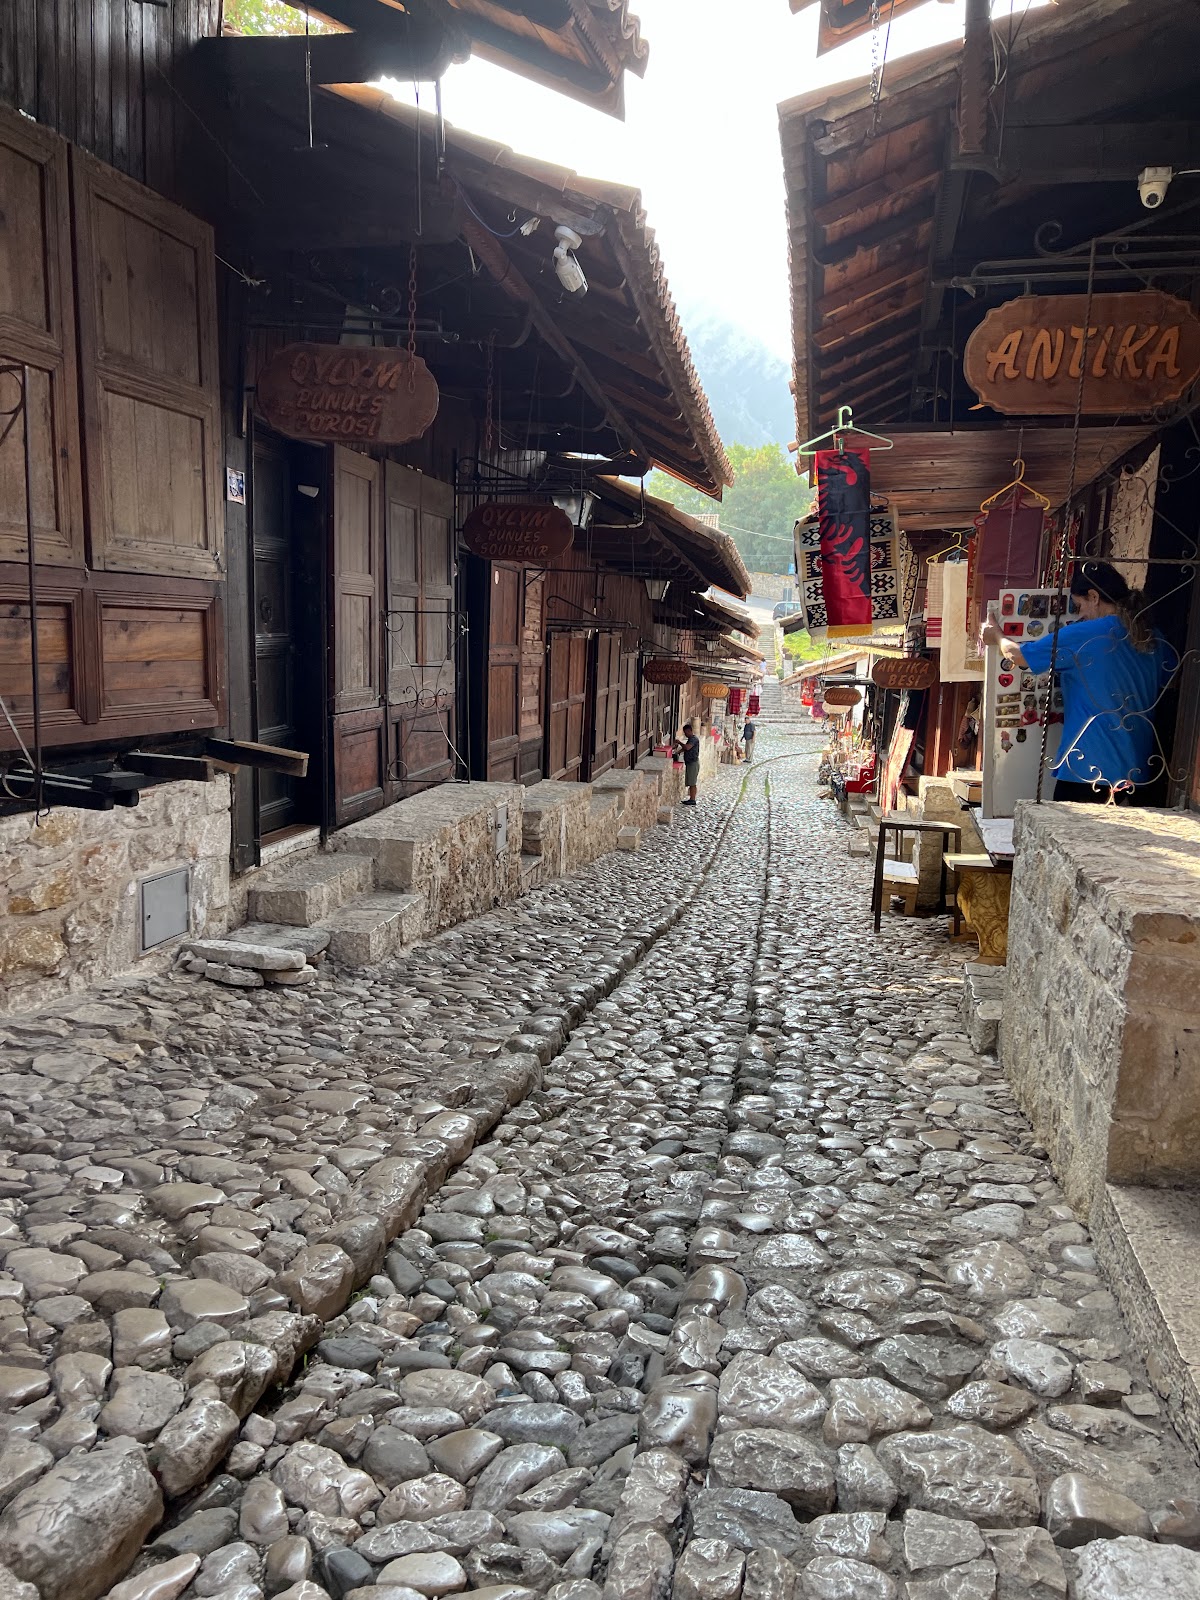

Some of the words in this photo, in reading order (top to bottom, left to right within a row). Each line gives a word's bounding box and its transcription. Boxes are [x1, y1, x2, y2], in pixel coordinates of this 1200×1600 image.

[986, 325, 1180, 382] ANTIKA
[487, 528, 541, 543] PUNUES
[480, 542, 549, 556] SOUVENIR
[877, 660, 930, 675] ANTIKA
[888, 674, 920, 687] BESI
